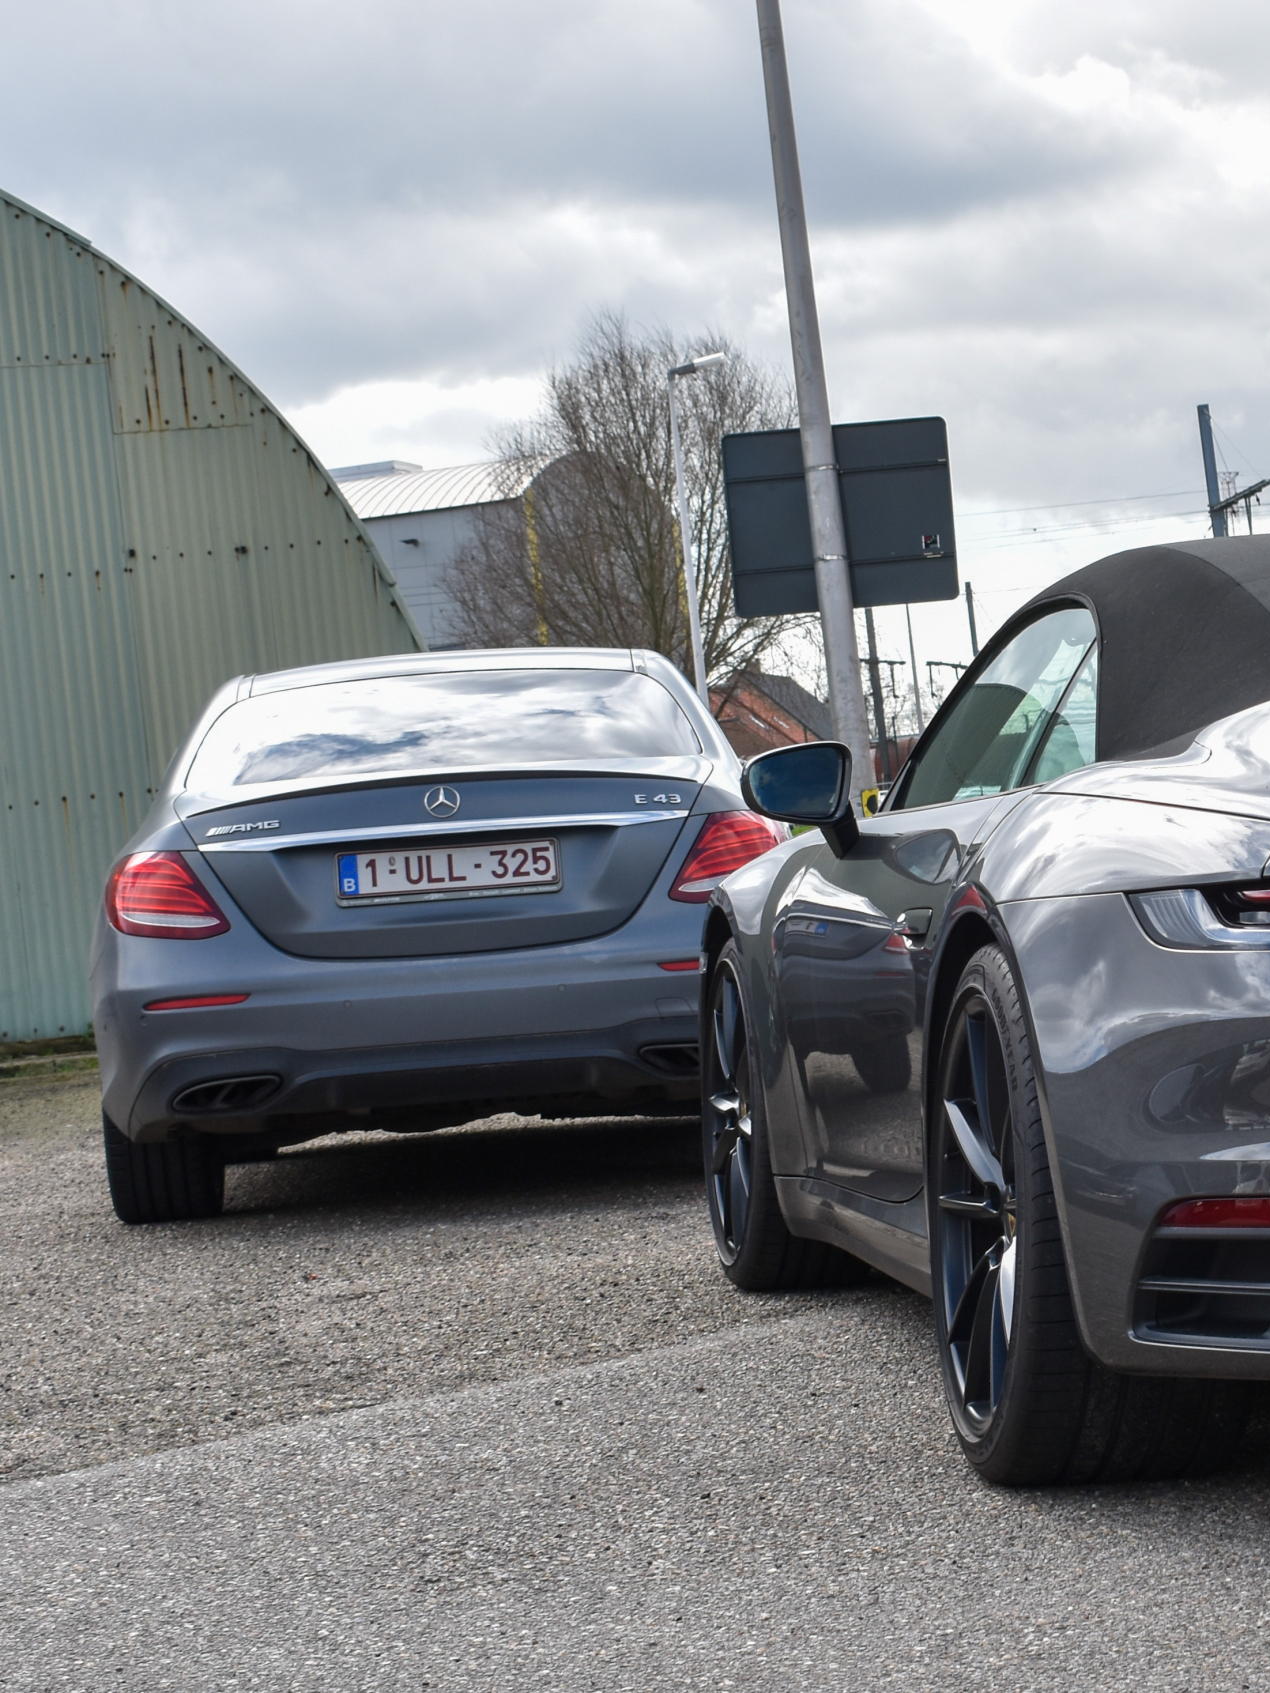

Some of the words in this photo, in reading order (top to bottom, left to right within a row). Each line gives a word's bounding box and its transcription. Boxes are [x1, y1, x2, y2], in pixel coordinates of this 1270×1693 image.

[634, 793, 648, 805] E
[652, 792, 682, 804] 43
[230, 819, 281, 832] AMG
[365, 846, 552, 888] 1-ULL-325
[343, 878, 356, 892] B
